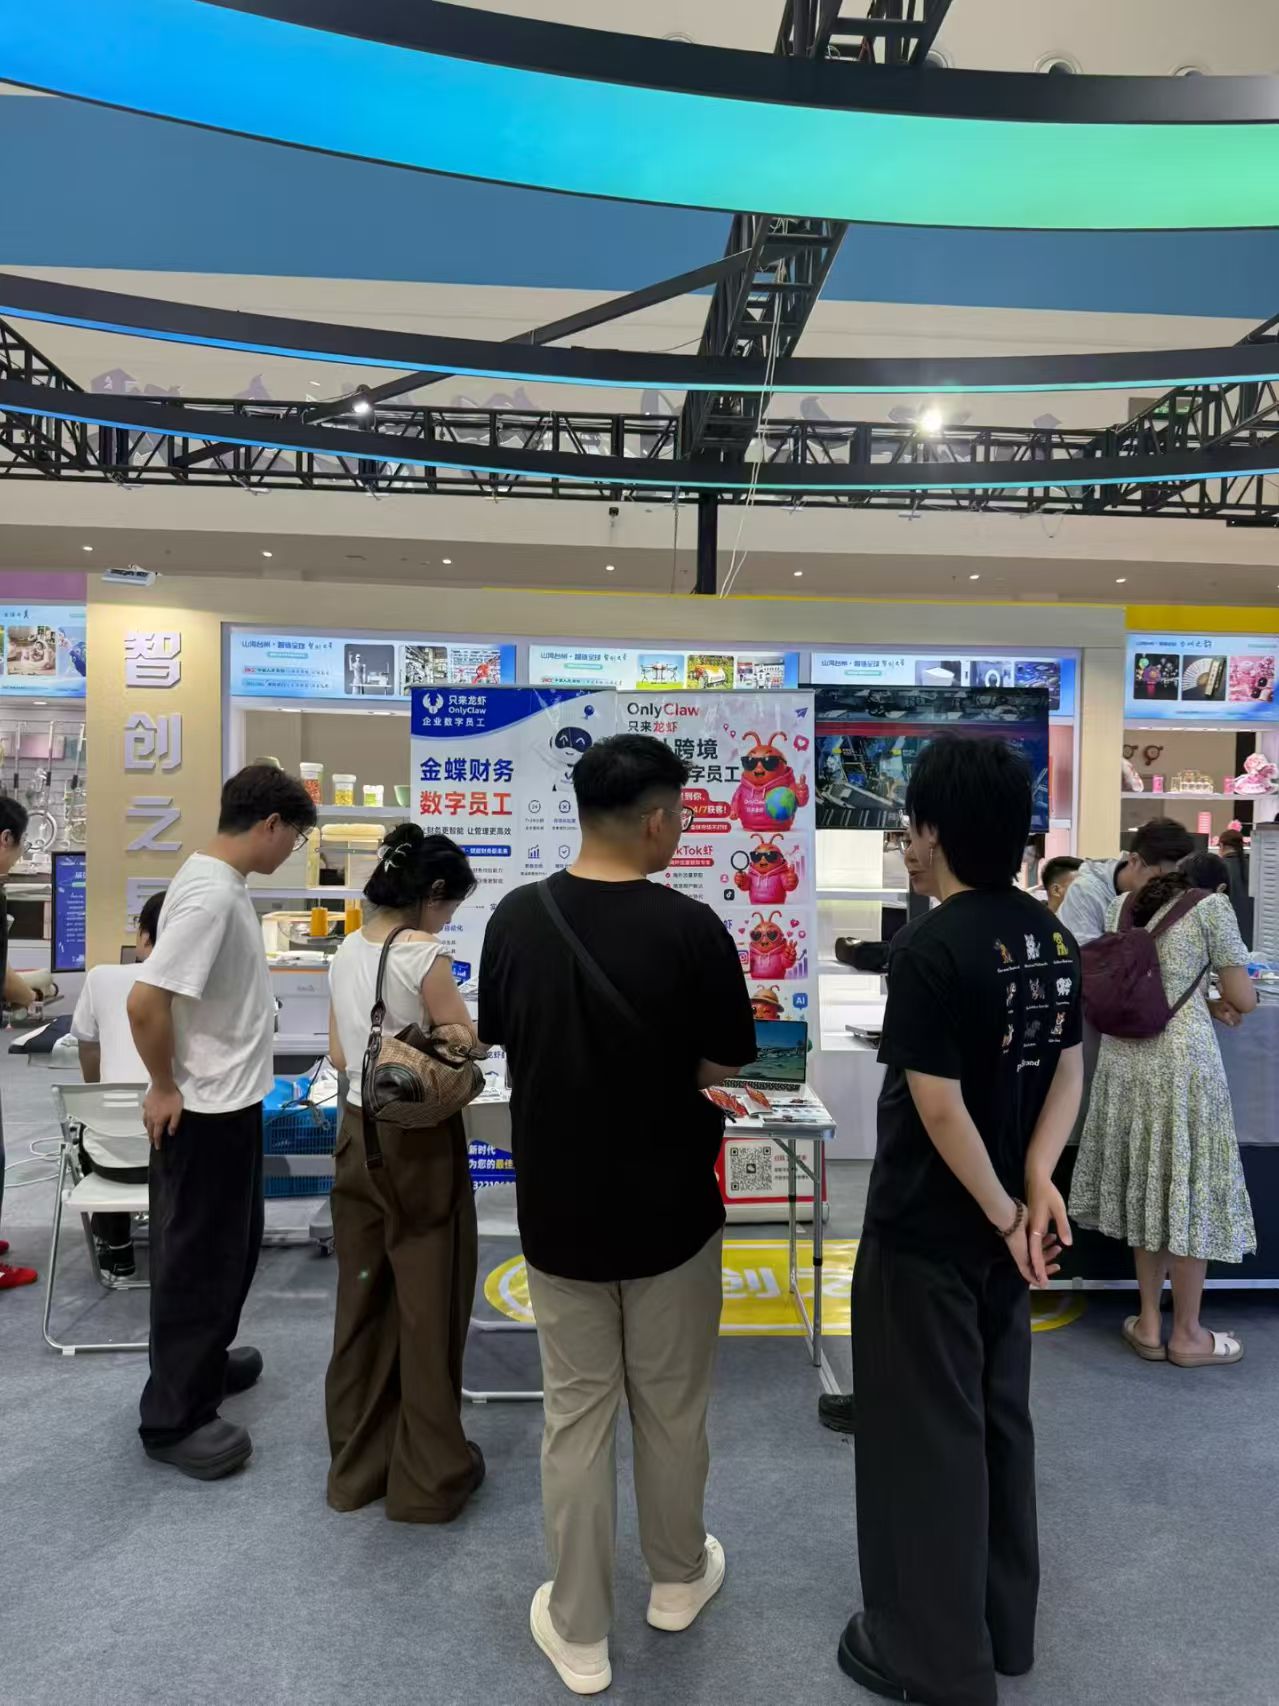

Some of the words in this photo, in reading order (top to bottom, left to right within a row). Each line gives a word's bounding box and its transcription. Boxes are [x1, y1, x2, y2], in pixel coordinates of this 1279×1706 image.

[448, 695, 487, 706] 只来龙虾
[448, 706, 487, 715] OnlyClaw
[627, 702, 700, 719] OnlyClaw
[422, 716, 486, 728] 企业数字员工
[627, 720, 679, 734] 只来龙虾
[664, 738, 719, 760] 跨境
[420, 756, 514, 783] 金蝶财务
[420, 790, 513, 816] 数字员工
[467, 826, 512, 836] 让管理更高效
[796, 996, 806, 1005] AI
